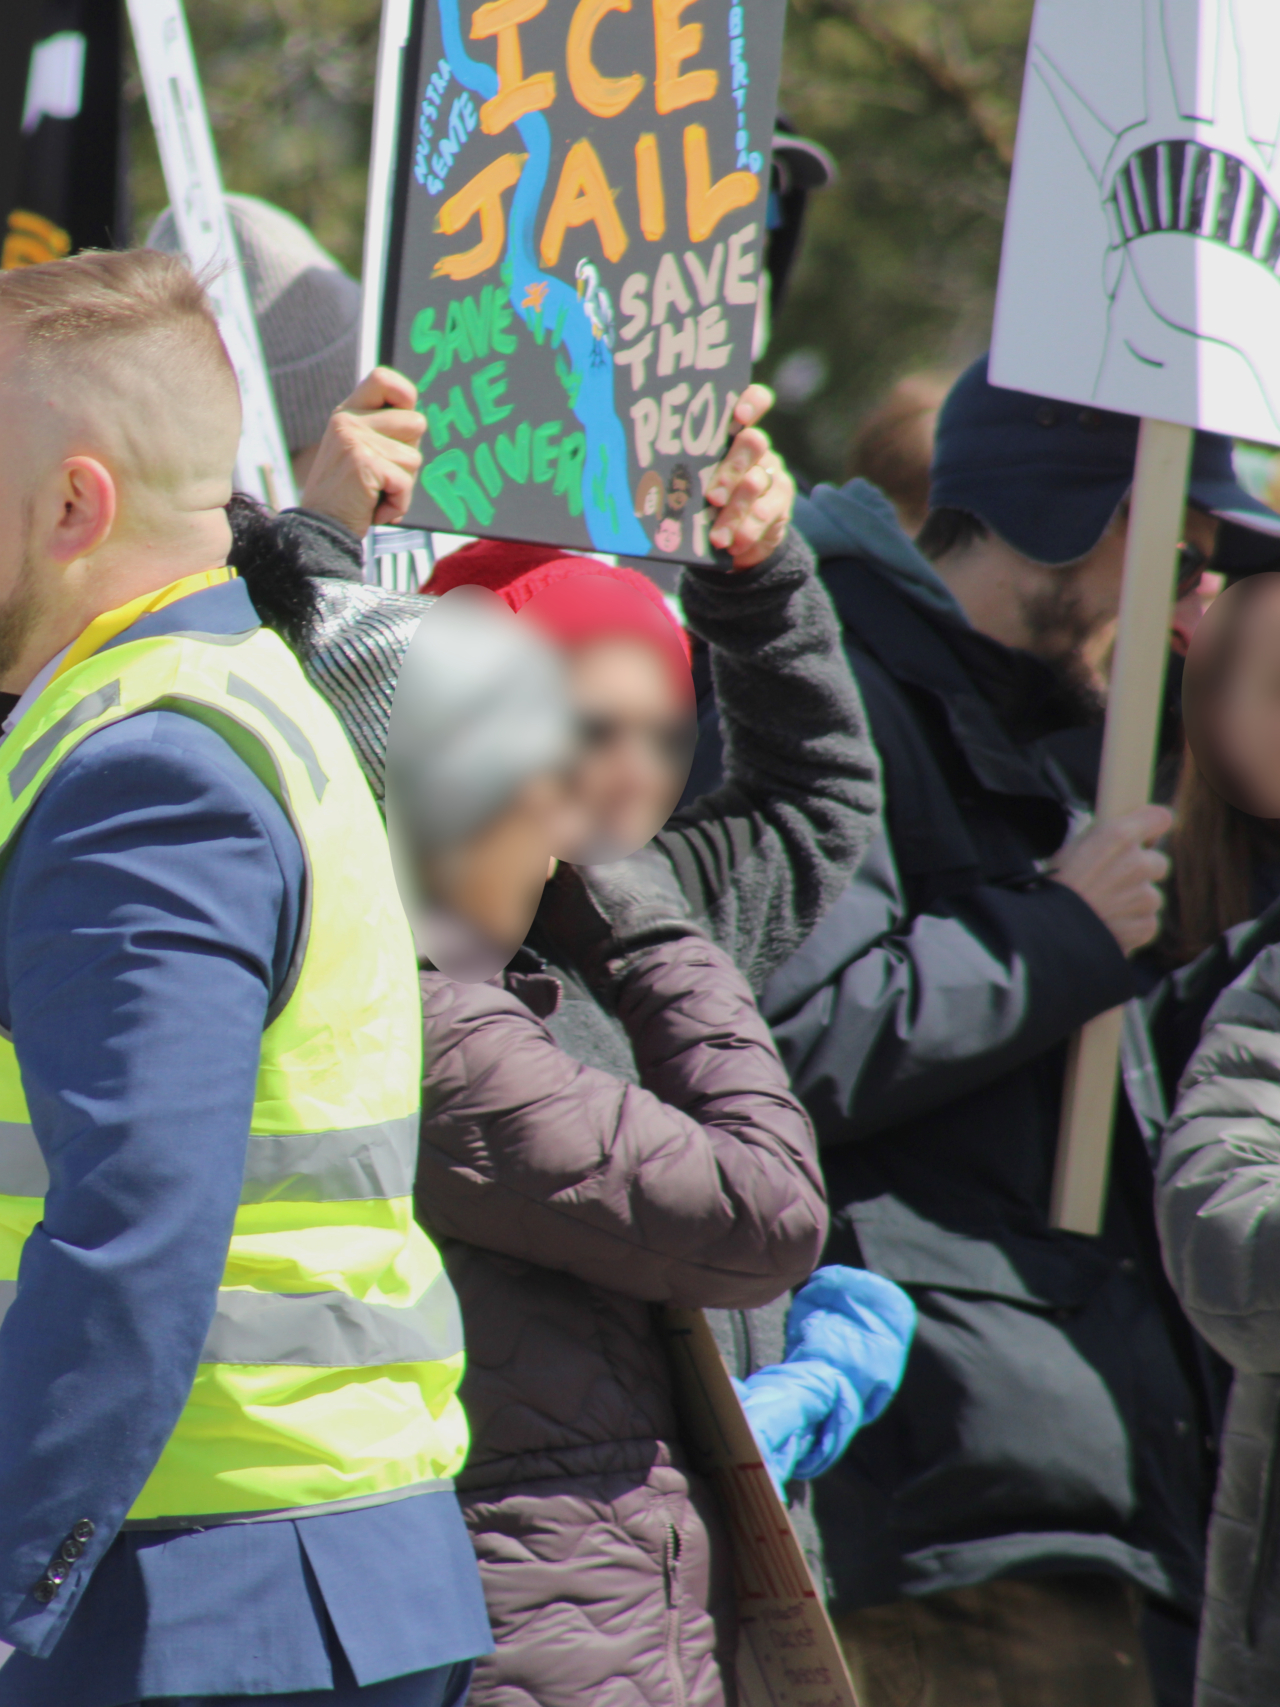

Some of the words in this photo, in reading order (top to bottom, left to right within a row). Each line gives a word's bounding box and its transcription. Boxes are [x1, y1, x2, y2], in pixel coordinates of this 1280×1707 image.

[414, 58, 452, 185] NUESTRA
[470, 0, 718, 135] ICE
[426, 90, 479, 196] GENTE
[430, 122, 760, 280] JAIL
[619, 222, 759, 341] SAVE
[409, 283, 518, 393] SAVE
[615, 304, 733, 391] THE
[417, 359, 515, 450] HE
[422, 420, 587, 531] RIVER
